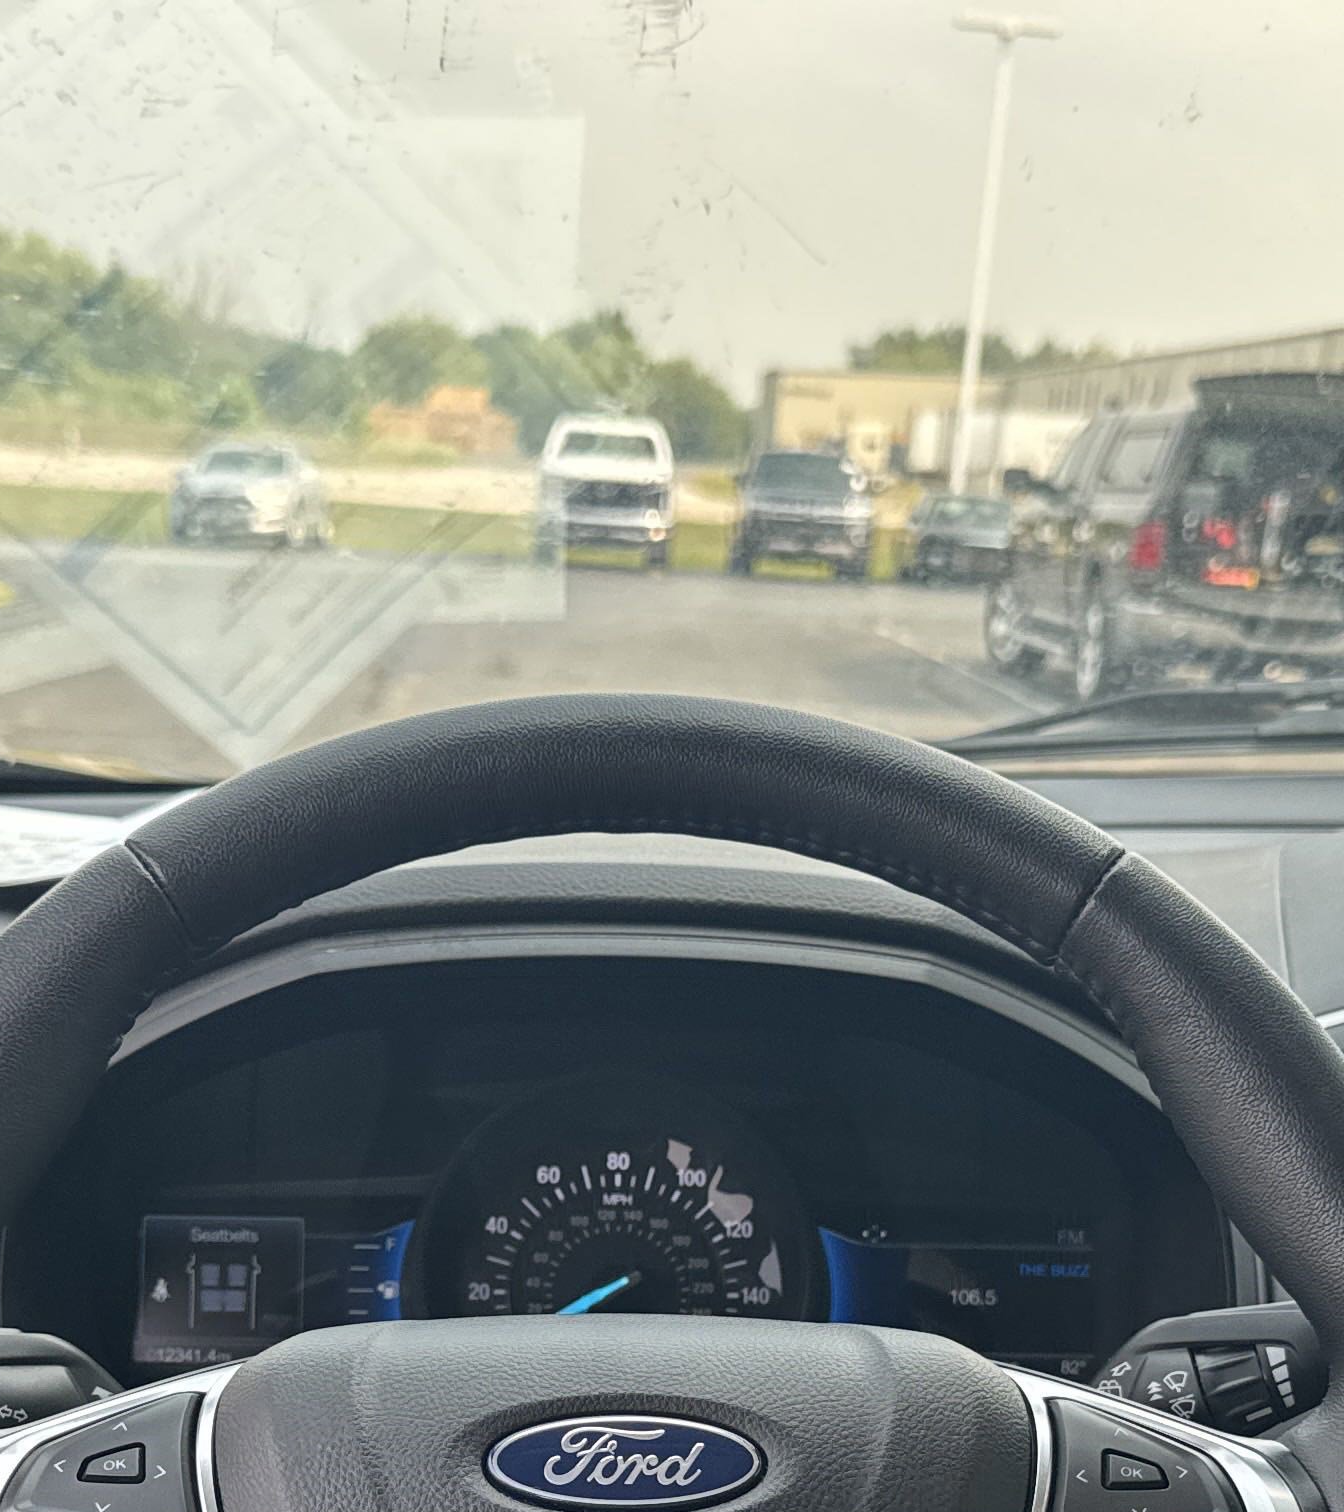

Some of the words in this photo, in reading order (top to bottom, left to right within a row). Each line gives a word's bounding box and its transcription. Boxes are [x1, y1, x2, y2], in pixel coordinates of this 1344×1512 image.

[607, 1152, 630, 1170] 80
[536, 1166, 560, 1184] 60
[677, 1169, 706, 1187] 100
[485, 1216, 508, 1234] 40
[725, 1221, 753, 1238] 120
[190, 1226, 259, 1243] Seatbelts
[468, 1283, 490, 1301] 20
[742, 1287, 770, 1304] 140
[951, 1290, 996, 1306] 106.5
[543, 1425, 705, 1486] Ford
[103, 1458, 127, 1471] OK
[1120, 1465, 1143, 1478] OK
